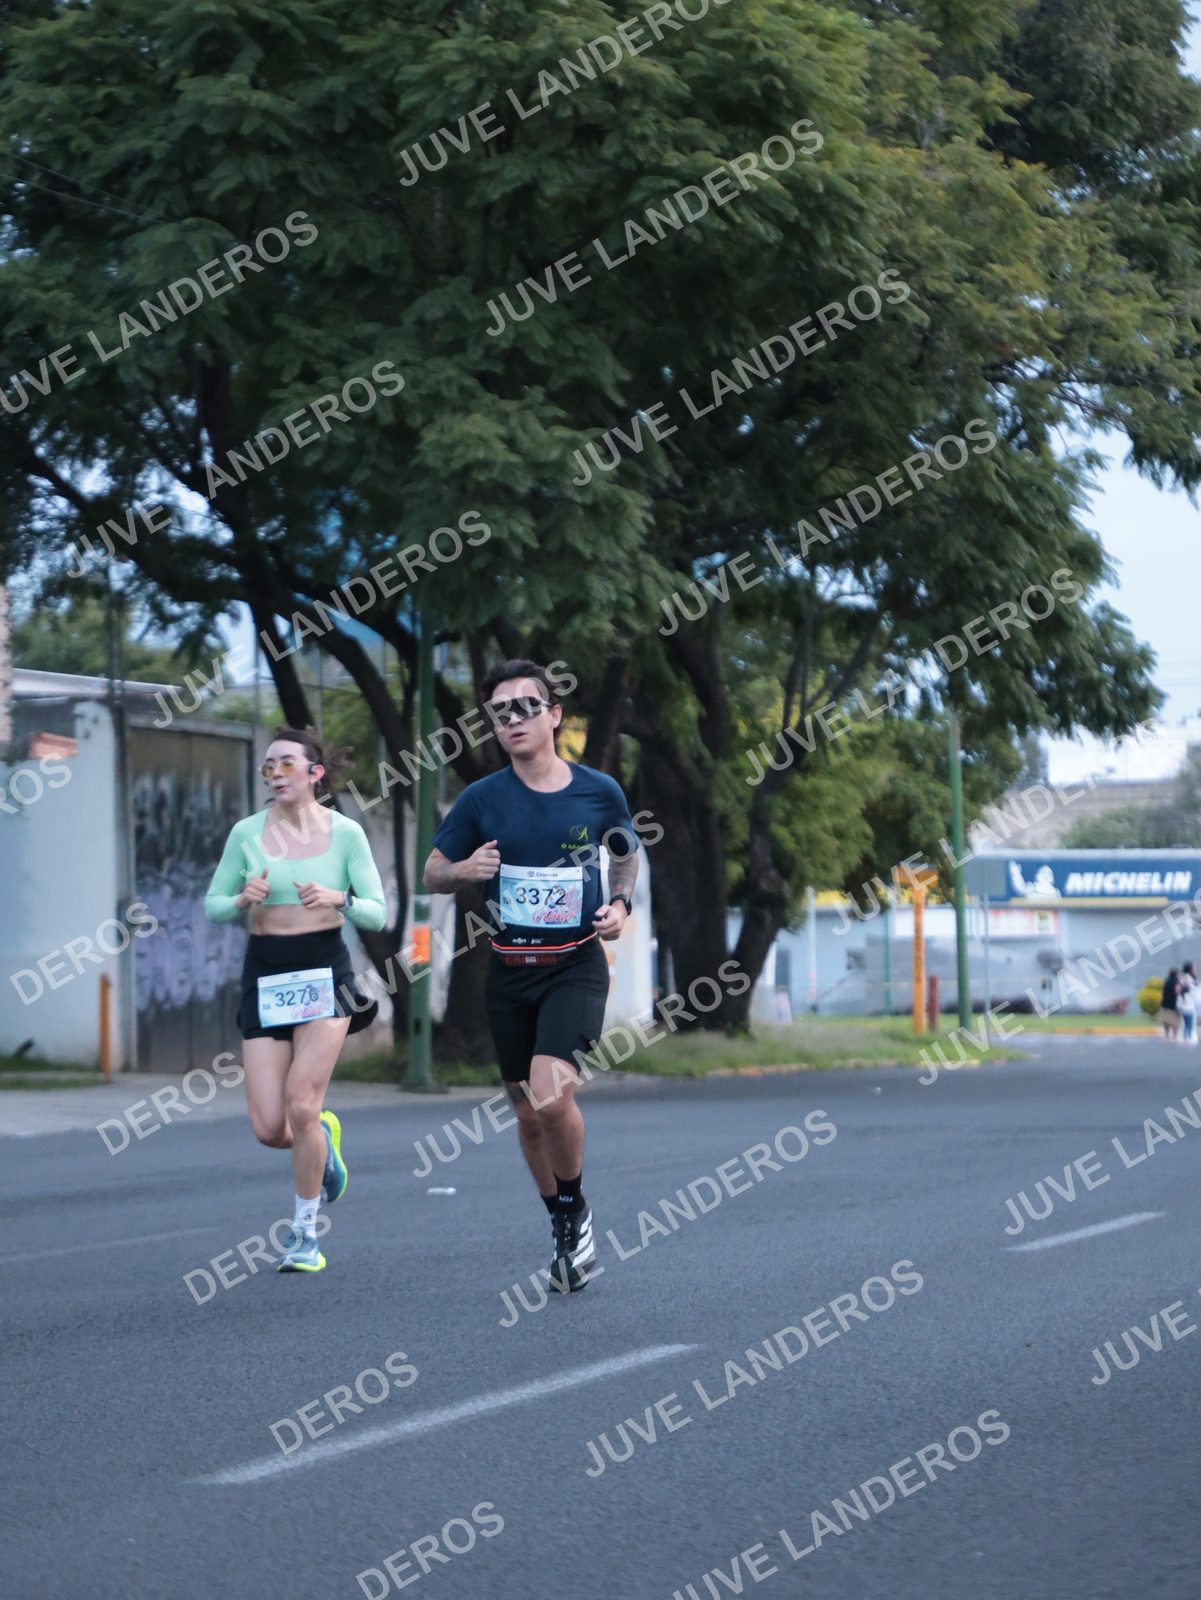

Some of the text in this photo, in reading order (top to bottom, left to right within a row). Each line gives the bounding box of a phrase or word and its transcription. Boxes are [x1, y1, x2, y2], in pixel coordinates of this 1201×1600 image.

[1064, 870, 1192, 895] MICHELIN
[516, 887, 567, 907] 3372
[275, 987, 319, 1007] 3276
